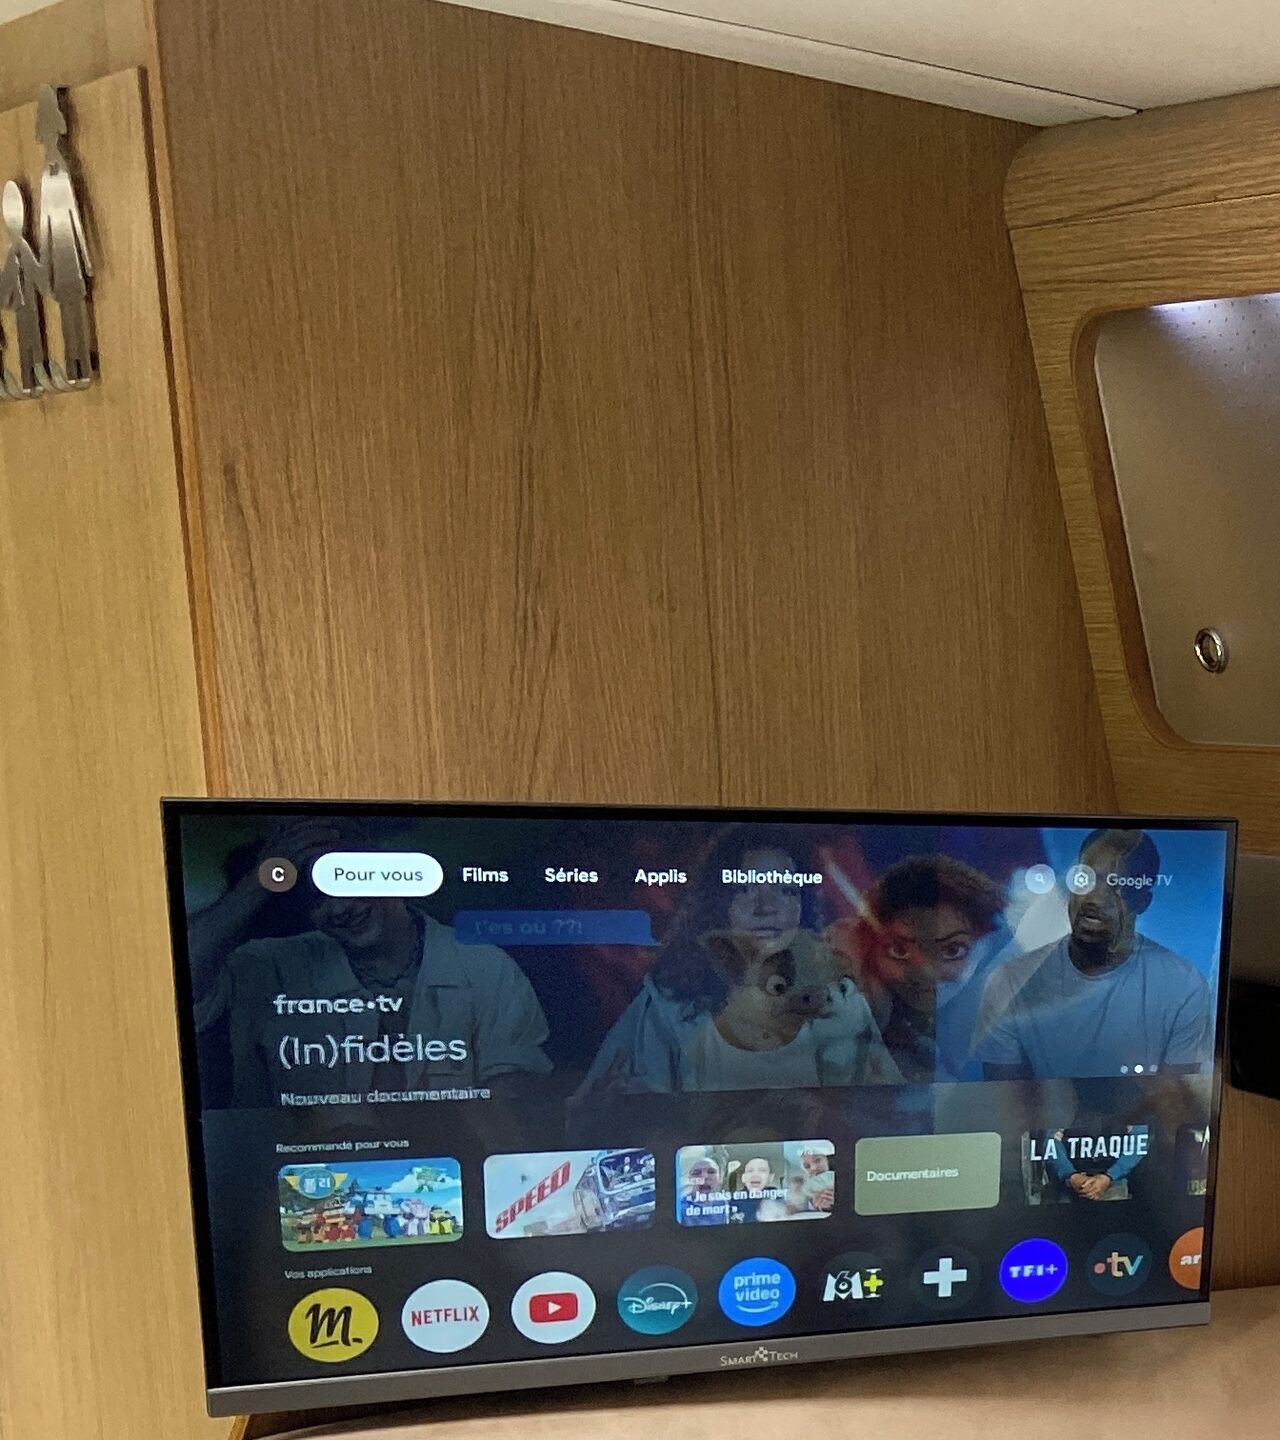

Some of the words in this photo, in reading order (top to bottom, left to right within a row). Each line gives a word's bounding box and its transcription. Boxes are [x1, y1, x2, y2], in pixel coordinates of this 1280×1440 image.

[271, 866, 286, 882] C
[334, 867, 375, 881] Pour
[381, 870, 424, 882] vous
[462, 867, 509, 883] Films
[545, 866, 599, 883] Séries
[635, 868, 688, 887] Applis
[721, 869, 823, 887] Bibliothèque
[1105, 872, 1153, 890] Google
[1155, 874, 1173, 886] TV
[278, 1033, 468, 1071] (In)fidèles
[280, 1091, 362, 1106] Nouveau
[366, 1086, 492, 1104] documentaire
[275, 1141, 353, 1154] Recommandé
[354, 1140, 380, 1152] pour
[383, 1139, 410, 1149] vous
[1030, 1138, 1058, 1161] LA
[1067, 1133, 1149, 1160] TRAQUE
[865, 1166, 960, 1182] Documentaires
[495, 1159, 572, 1235] SPEED
[708, 1189, 732, 1201] suis
[733, 1190, 748, 1201] en
[750, 1187, 789, 1201] danger
[686, 1204, 701, 1216] de
[702, 1202, 731, 1216] mort
[284, 1269, 305, 1280] Vos
[306, 1265, 373, 1281] applications
[1008, 1264, 1058, 1279] TF1+
[733, 1272, 782, 1291] prime
[735, 1285, 781, 1302] video
[623, 1292, 693, 1315] Disney+
[411, 1305, 480, 1328] NETFLIX
[768, 1350, 799, 1361] TECH
